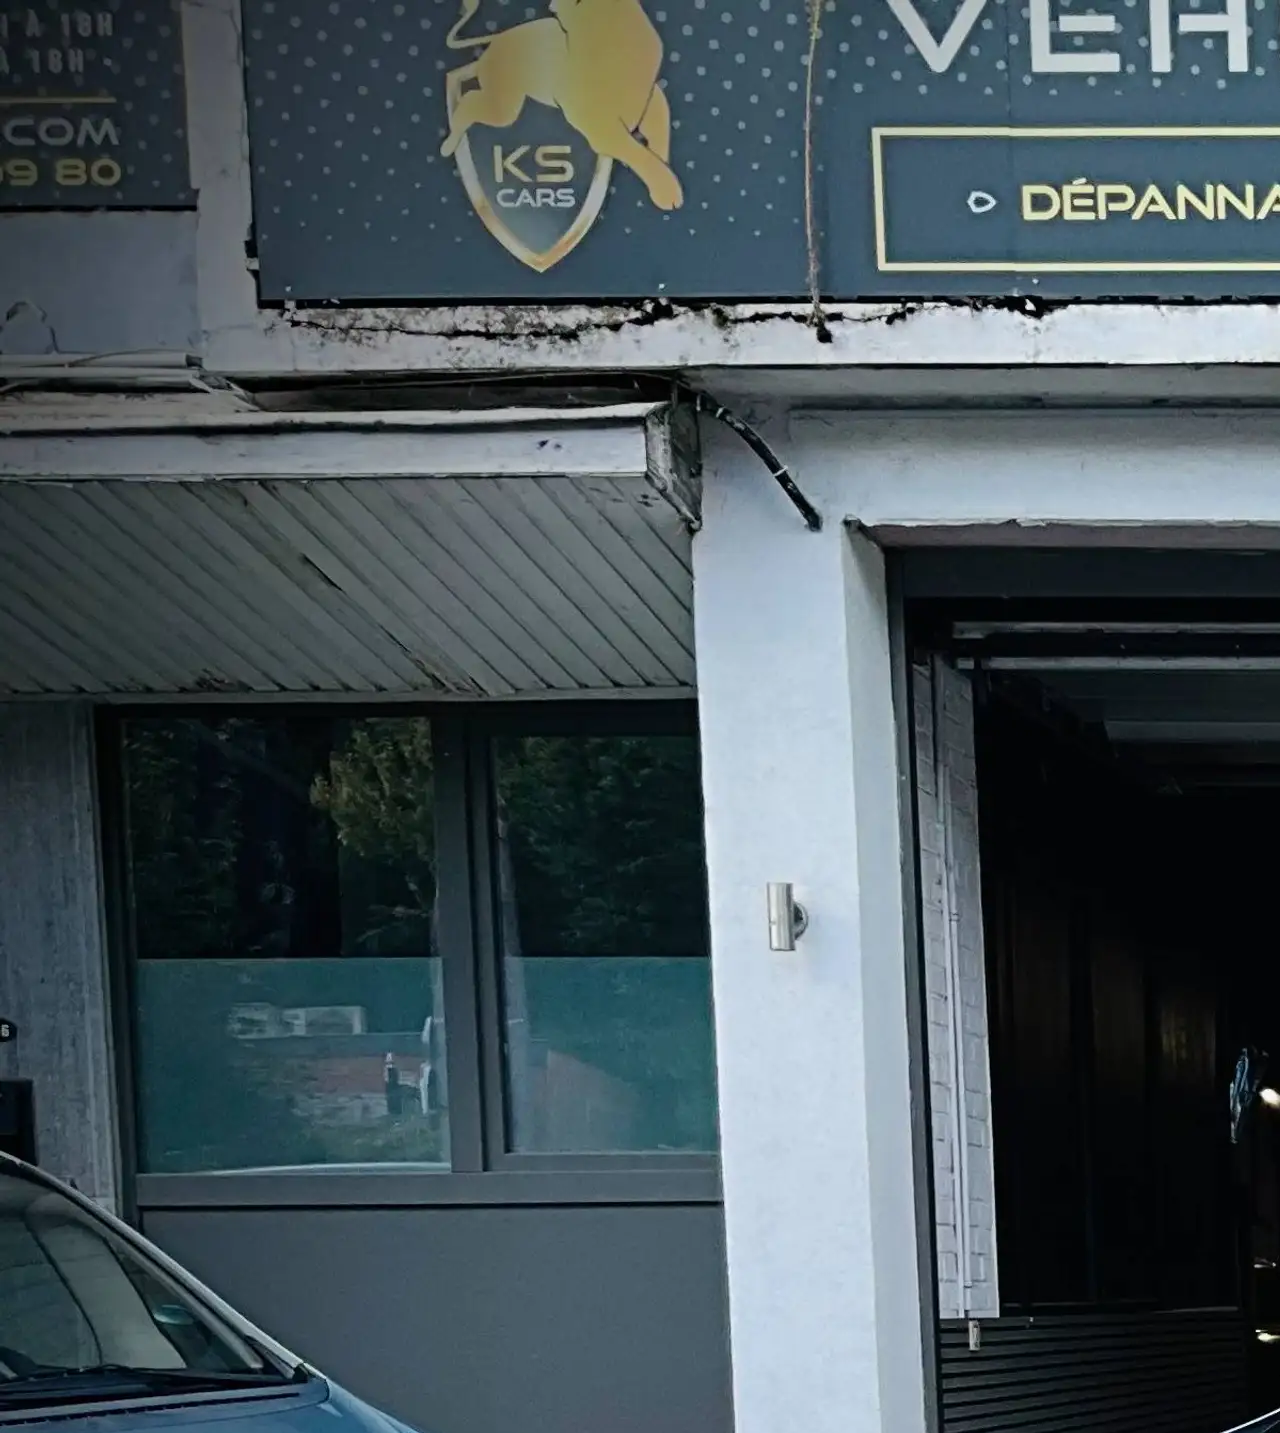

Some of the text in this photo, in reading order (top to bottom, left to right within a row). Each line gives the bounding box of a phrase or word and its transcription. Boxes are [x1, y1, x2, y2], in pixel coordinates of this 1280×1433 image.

[55, 158, 122, 186] 80
[493, 145, 575, 183] KS
[496, 187, 576, 209] CARS
